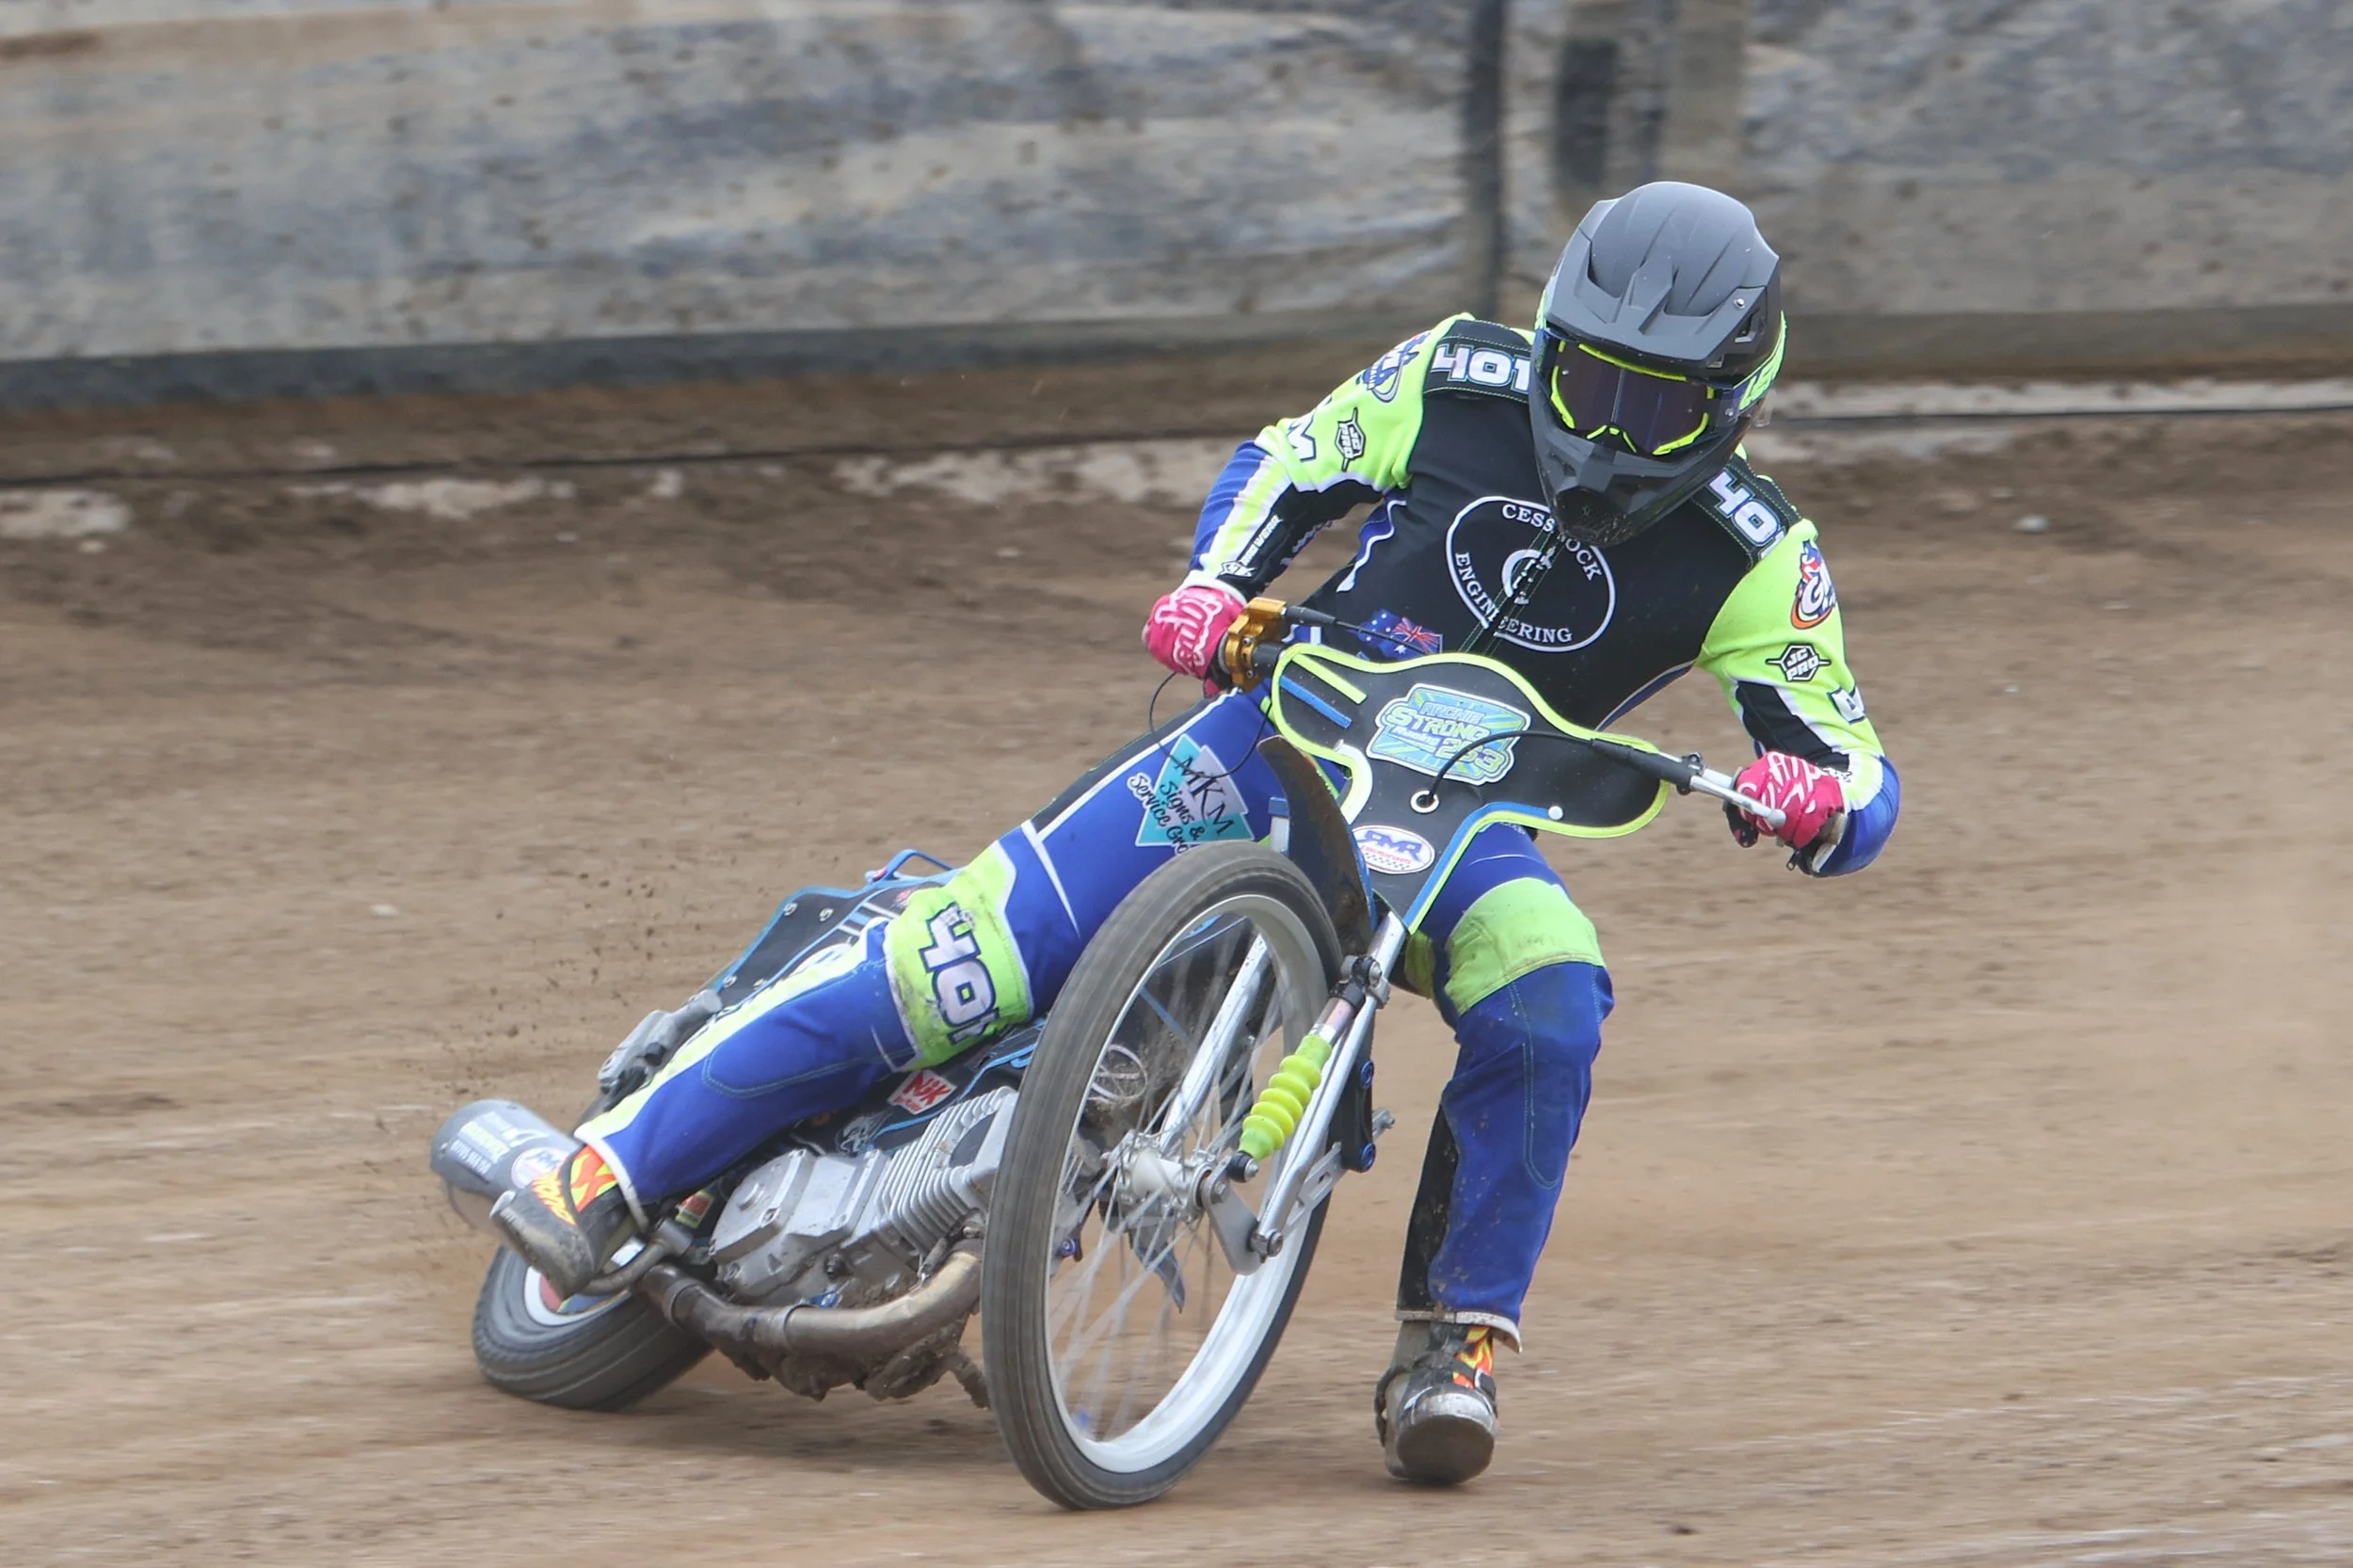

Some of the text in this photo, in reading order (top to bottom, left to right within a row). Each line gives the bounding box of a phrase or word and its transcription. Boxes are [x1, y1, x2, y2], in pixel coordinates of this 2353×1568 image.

[1432, 344, 1531, 394] 401
[1502, 504, 1602, 581] CESSOCK
[1786, 648, 1808, 668] JC
[1786, 655, 1820, 681] PRO
[1385, 706, 1492, 741] STRONG
[1129, 775, 1190, 855] Service Gro
[1160, 780, 1194, 825] Signs
